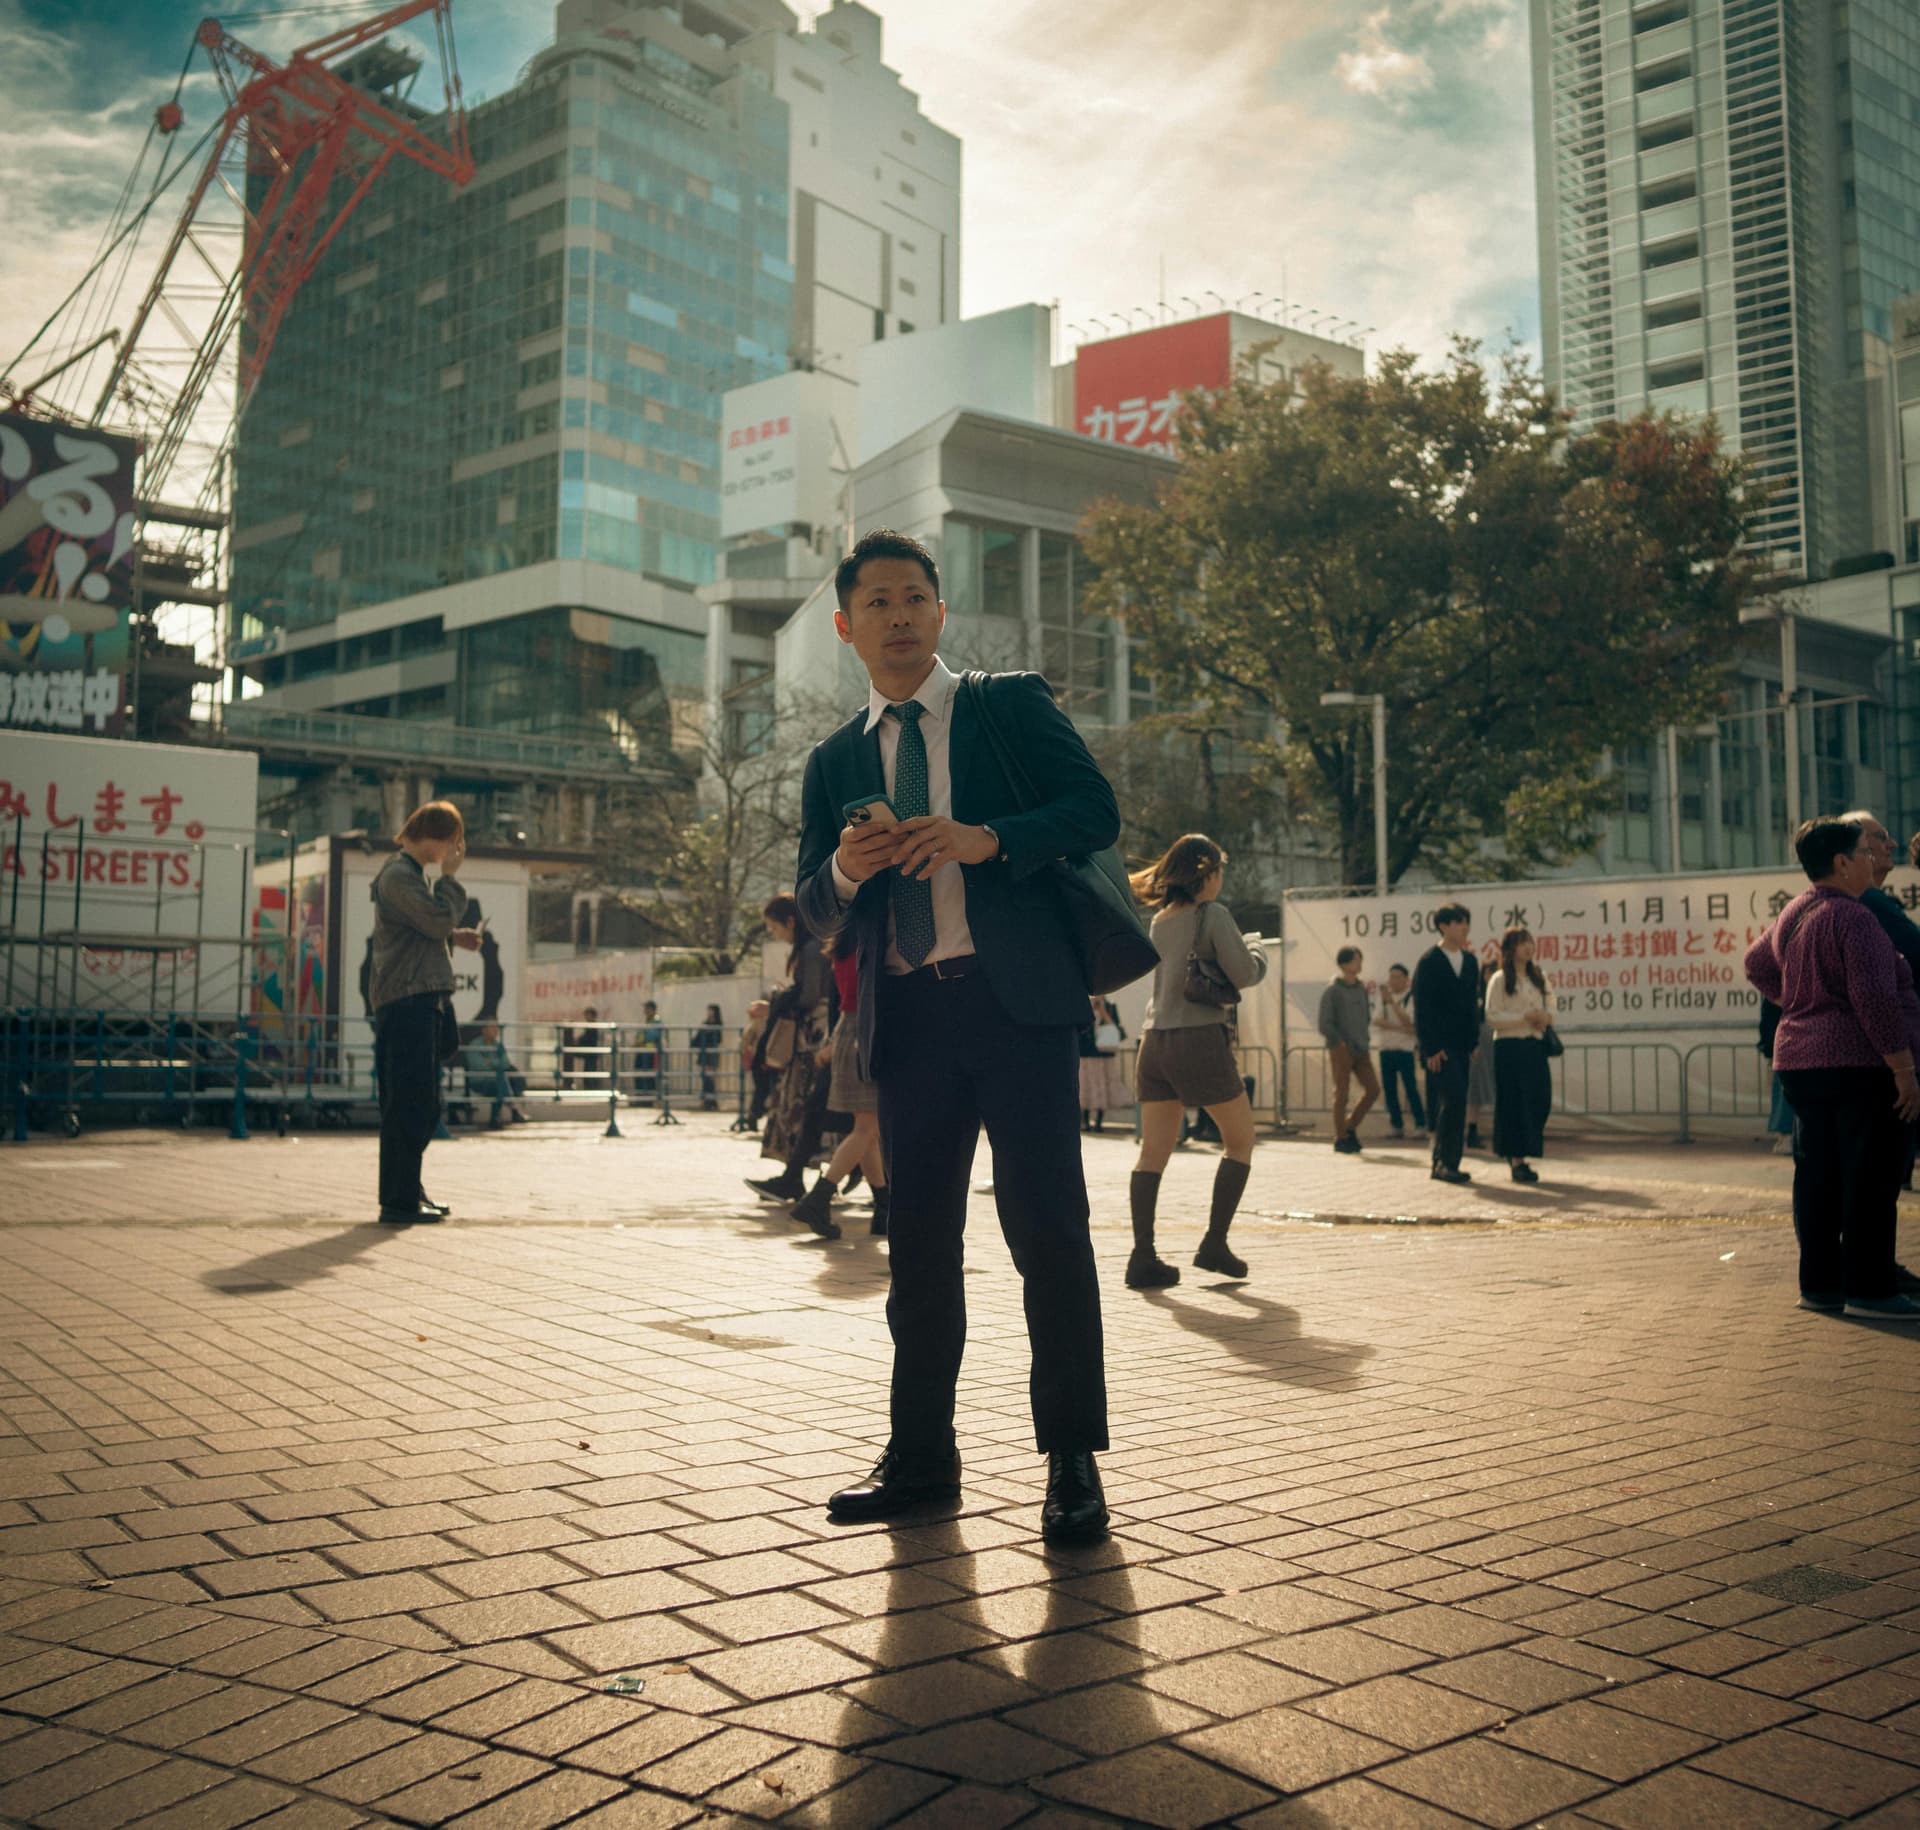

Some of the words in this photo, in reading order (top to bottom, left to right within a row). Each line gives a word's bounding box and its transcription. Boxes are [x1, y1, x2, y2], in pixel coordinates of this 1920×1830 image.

[1083, 387, 1200, 443] カラオ
[39, 847, 203, 889] STREETS.
[453, 973, 479, 992] CK
[1547, 965, 1610, 989] statue
[1619, 963, 1639, 986] of
[1648, 960, 1735, 986] Hachiko
[1556, 994, 1576, 1012] er
[1585, 988, 1614, 1011] 30
[1623, 989, 1643, 1010] to
[1651, 988, 1718, 1012] Friday
[1727, 988, 1764, 1008] mo
